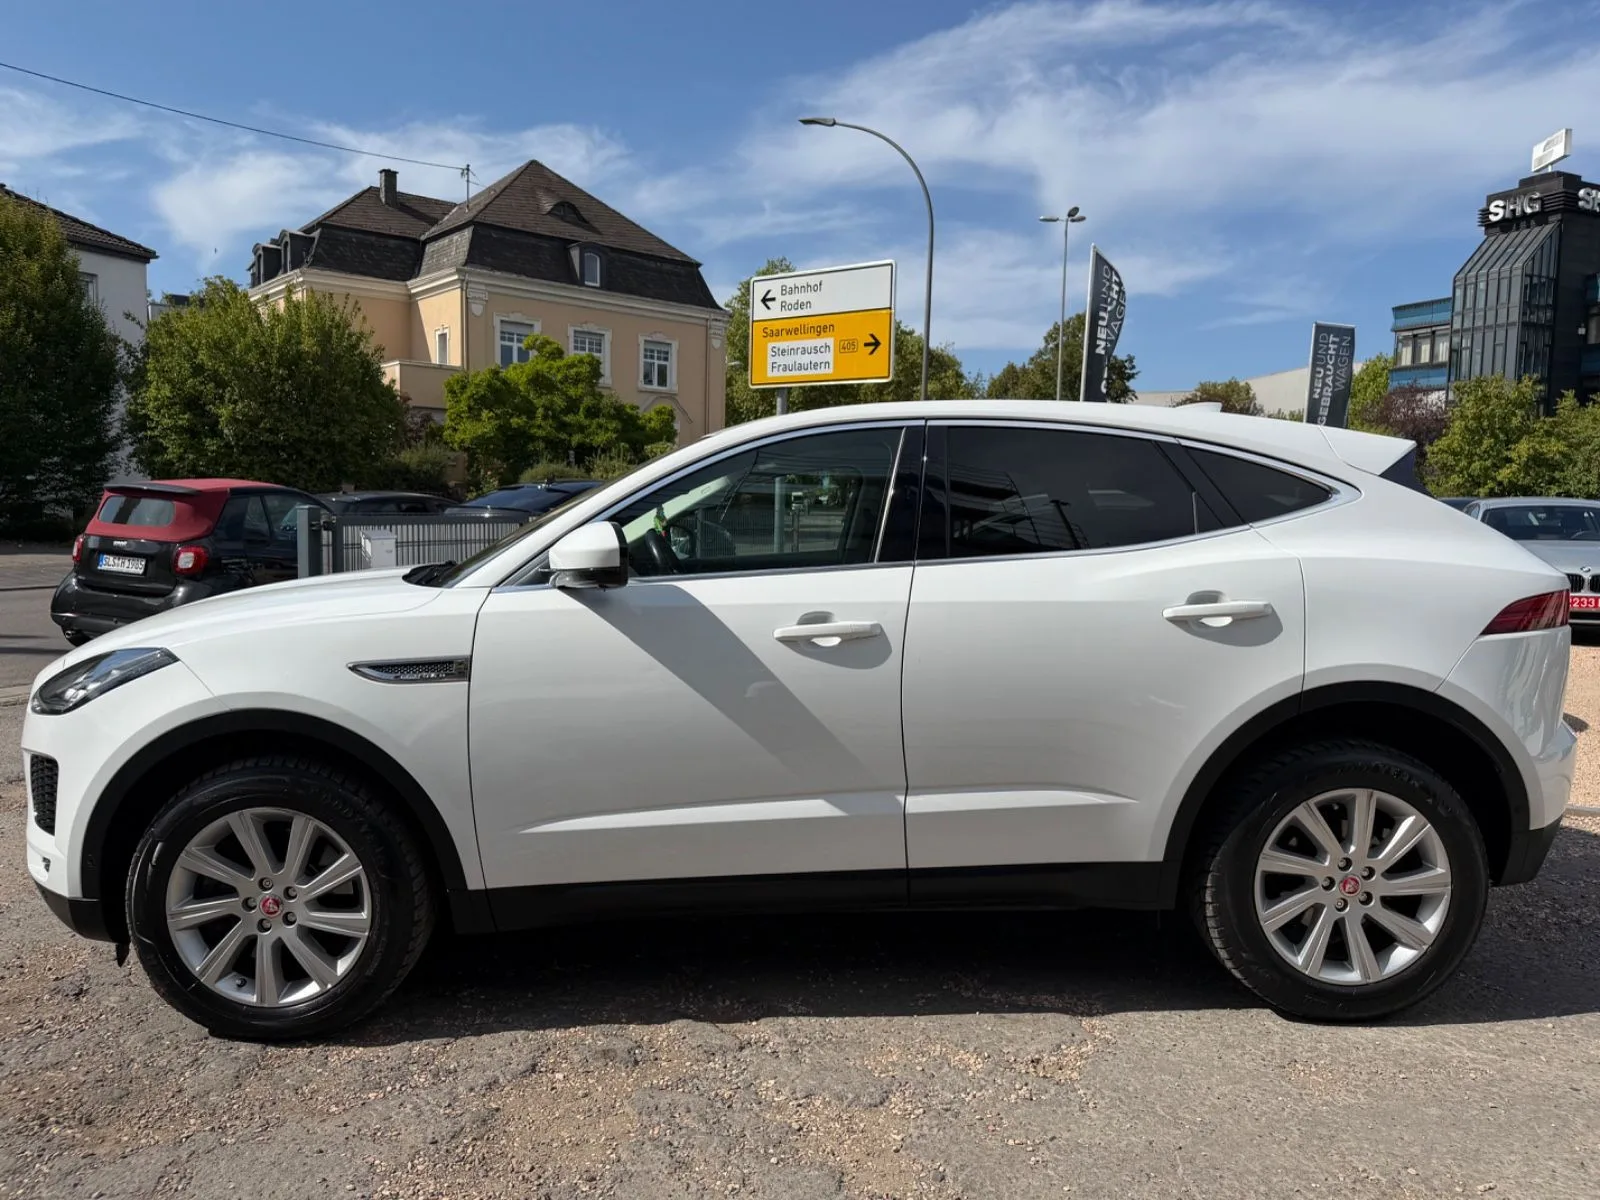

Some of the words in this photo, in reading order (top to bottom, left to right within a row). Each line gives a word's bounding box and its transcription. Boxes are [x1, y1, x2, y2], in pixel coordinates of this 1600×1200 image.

[1488, 191, 1541, 222] SHG
[780, 280, 823, 296] Bahnhof
[780, 299, 812, 312] Roden
[762, 323, 835, 338] Saarwellingen
[1095, 311, 1108, 355] NEU
[771, 342, 831, 357] Steinrausch
[841, 341, 856, 352] 405
[1316, 332, 1329, 366] UND
[771, 360, 830, 373] Fraulautern
[1334, 335, 1351, 392] WAGEN
[1313, 369, 1324, 399] NEU
[1317, 334, 1340, 426] GEBRAUCHT
[1570, 597, 1595, 608] 233
